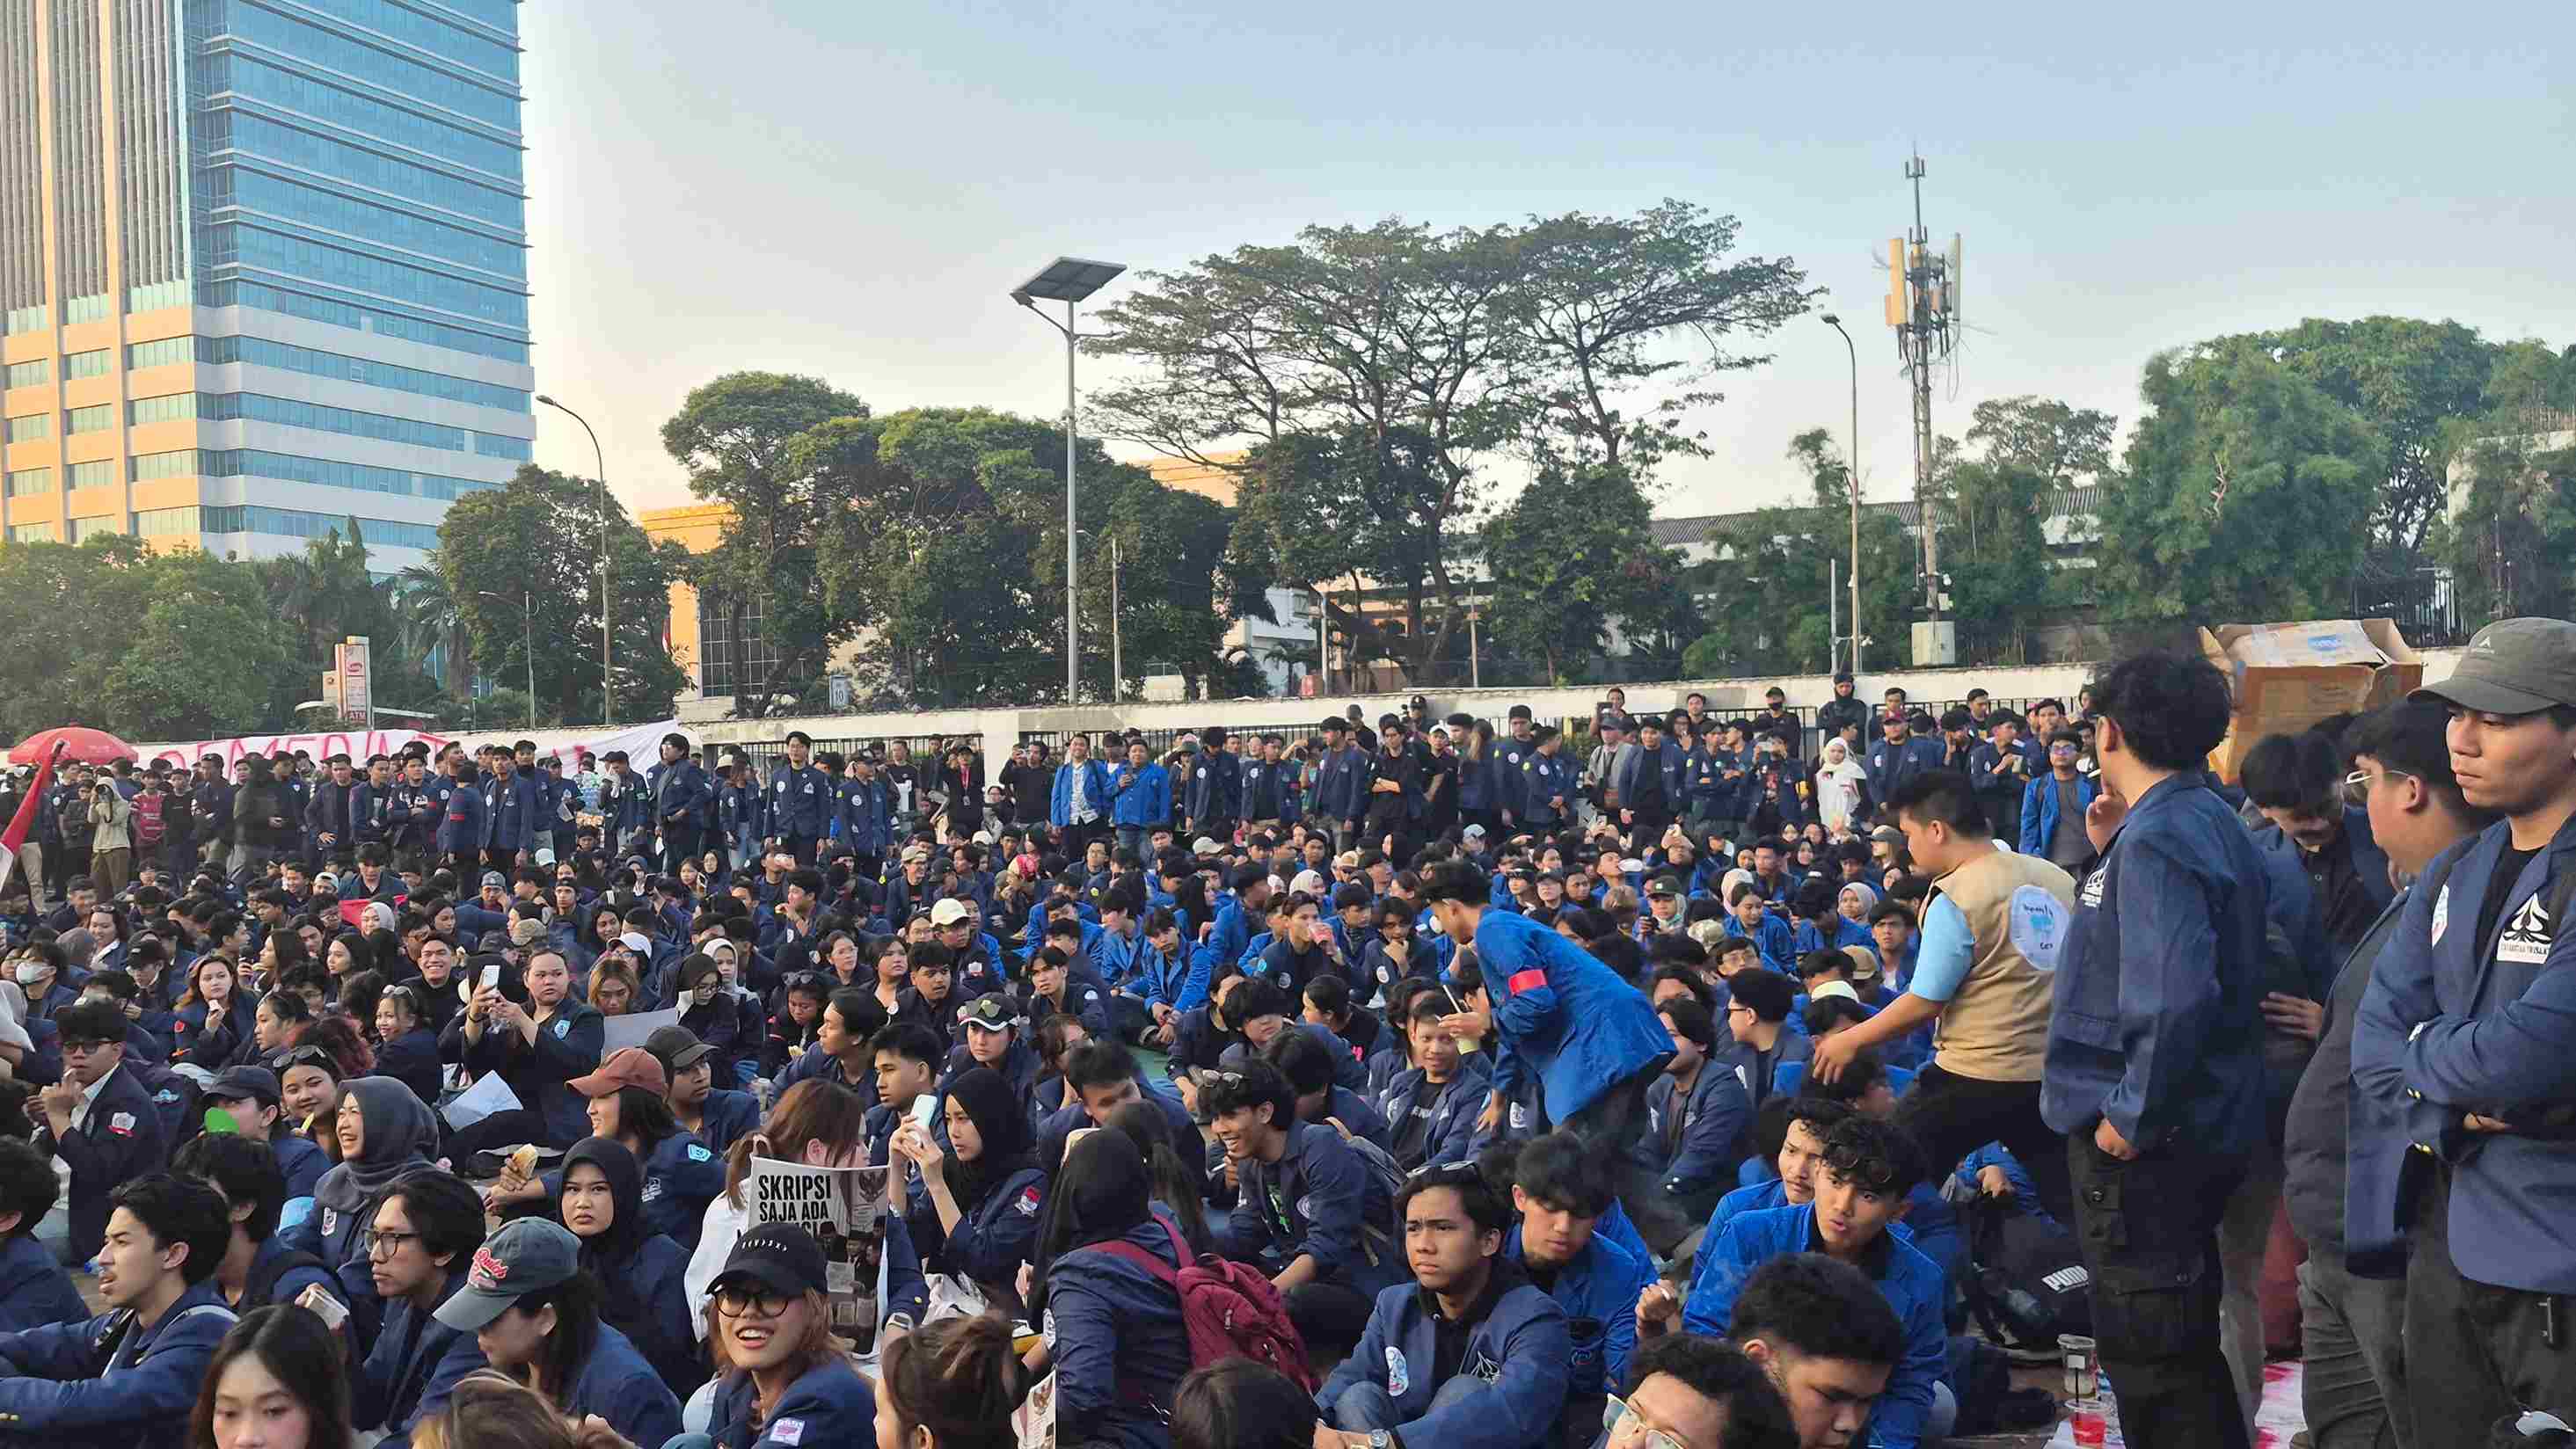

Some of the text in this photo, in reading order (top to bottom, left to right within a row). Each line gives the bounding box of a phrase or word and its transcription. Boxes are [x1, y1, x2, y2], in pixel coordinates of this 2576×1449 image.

[758, 1175, 831, 1201] SKRIPSI
[759, 1201, 828, 1222] SAJA ADA
